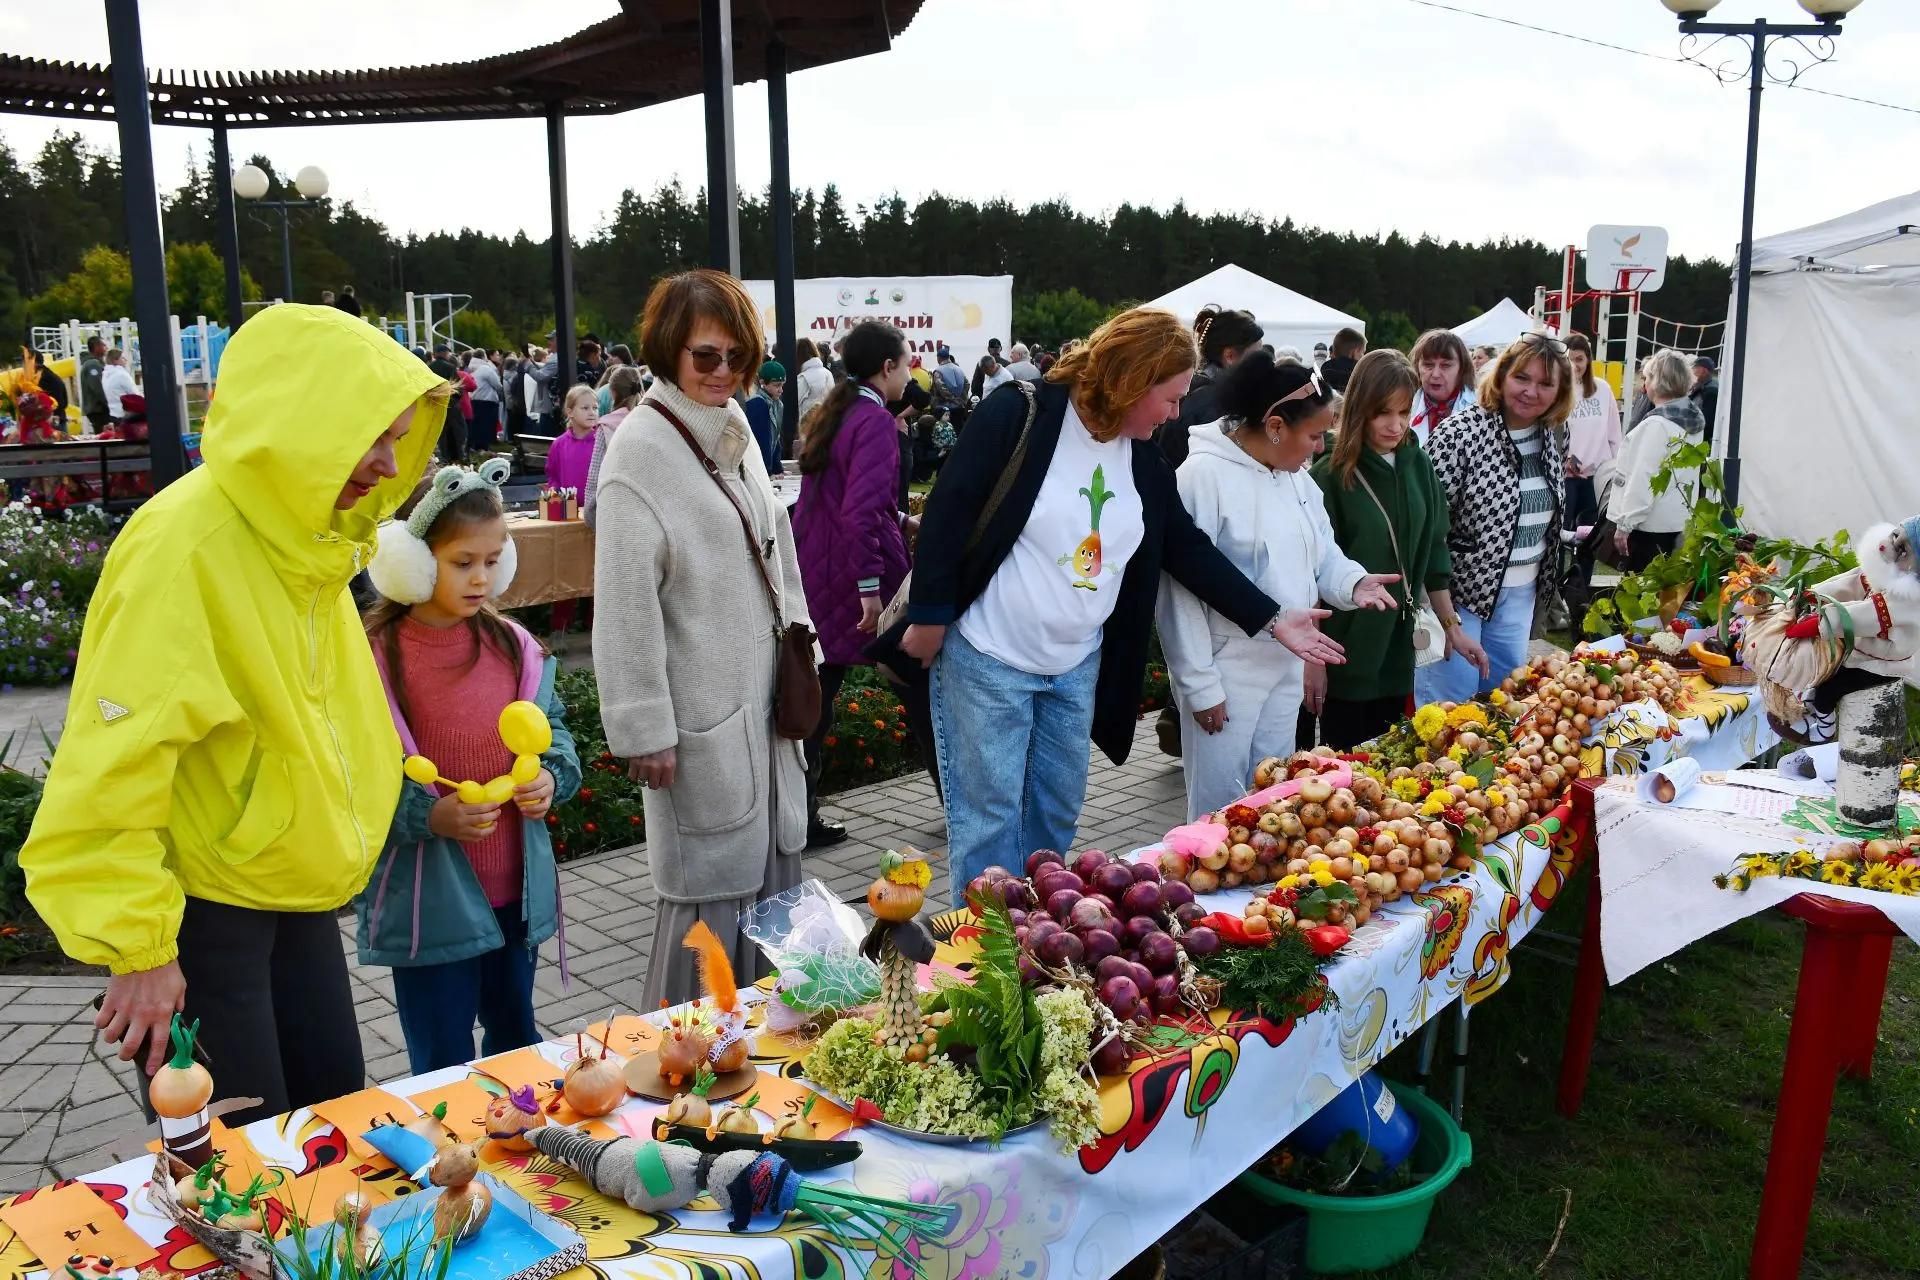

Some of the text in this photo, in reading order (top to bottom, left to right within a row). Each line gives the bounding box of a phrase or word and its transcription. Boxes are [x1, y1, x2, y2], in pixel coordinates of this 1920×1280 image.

[811, 312, 933, 338] ЛУКЫЙ
[624, 1031, 652, 1042] 35
[64, 1222, 103, 1241] 14
